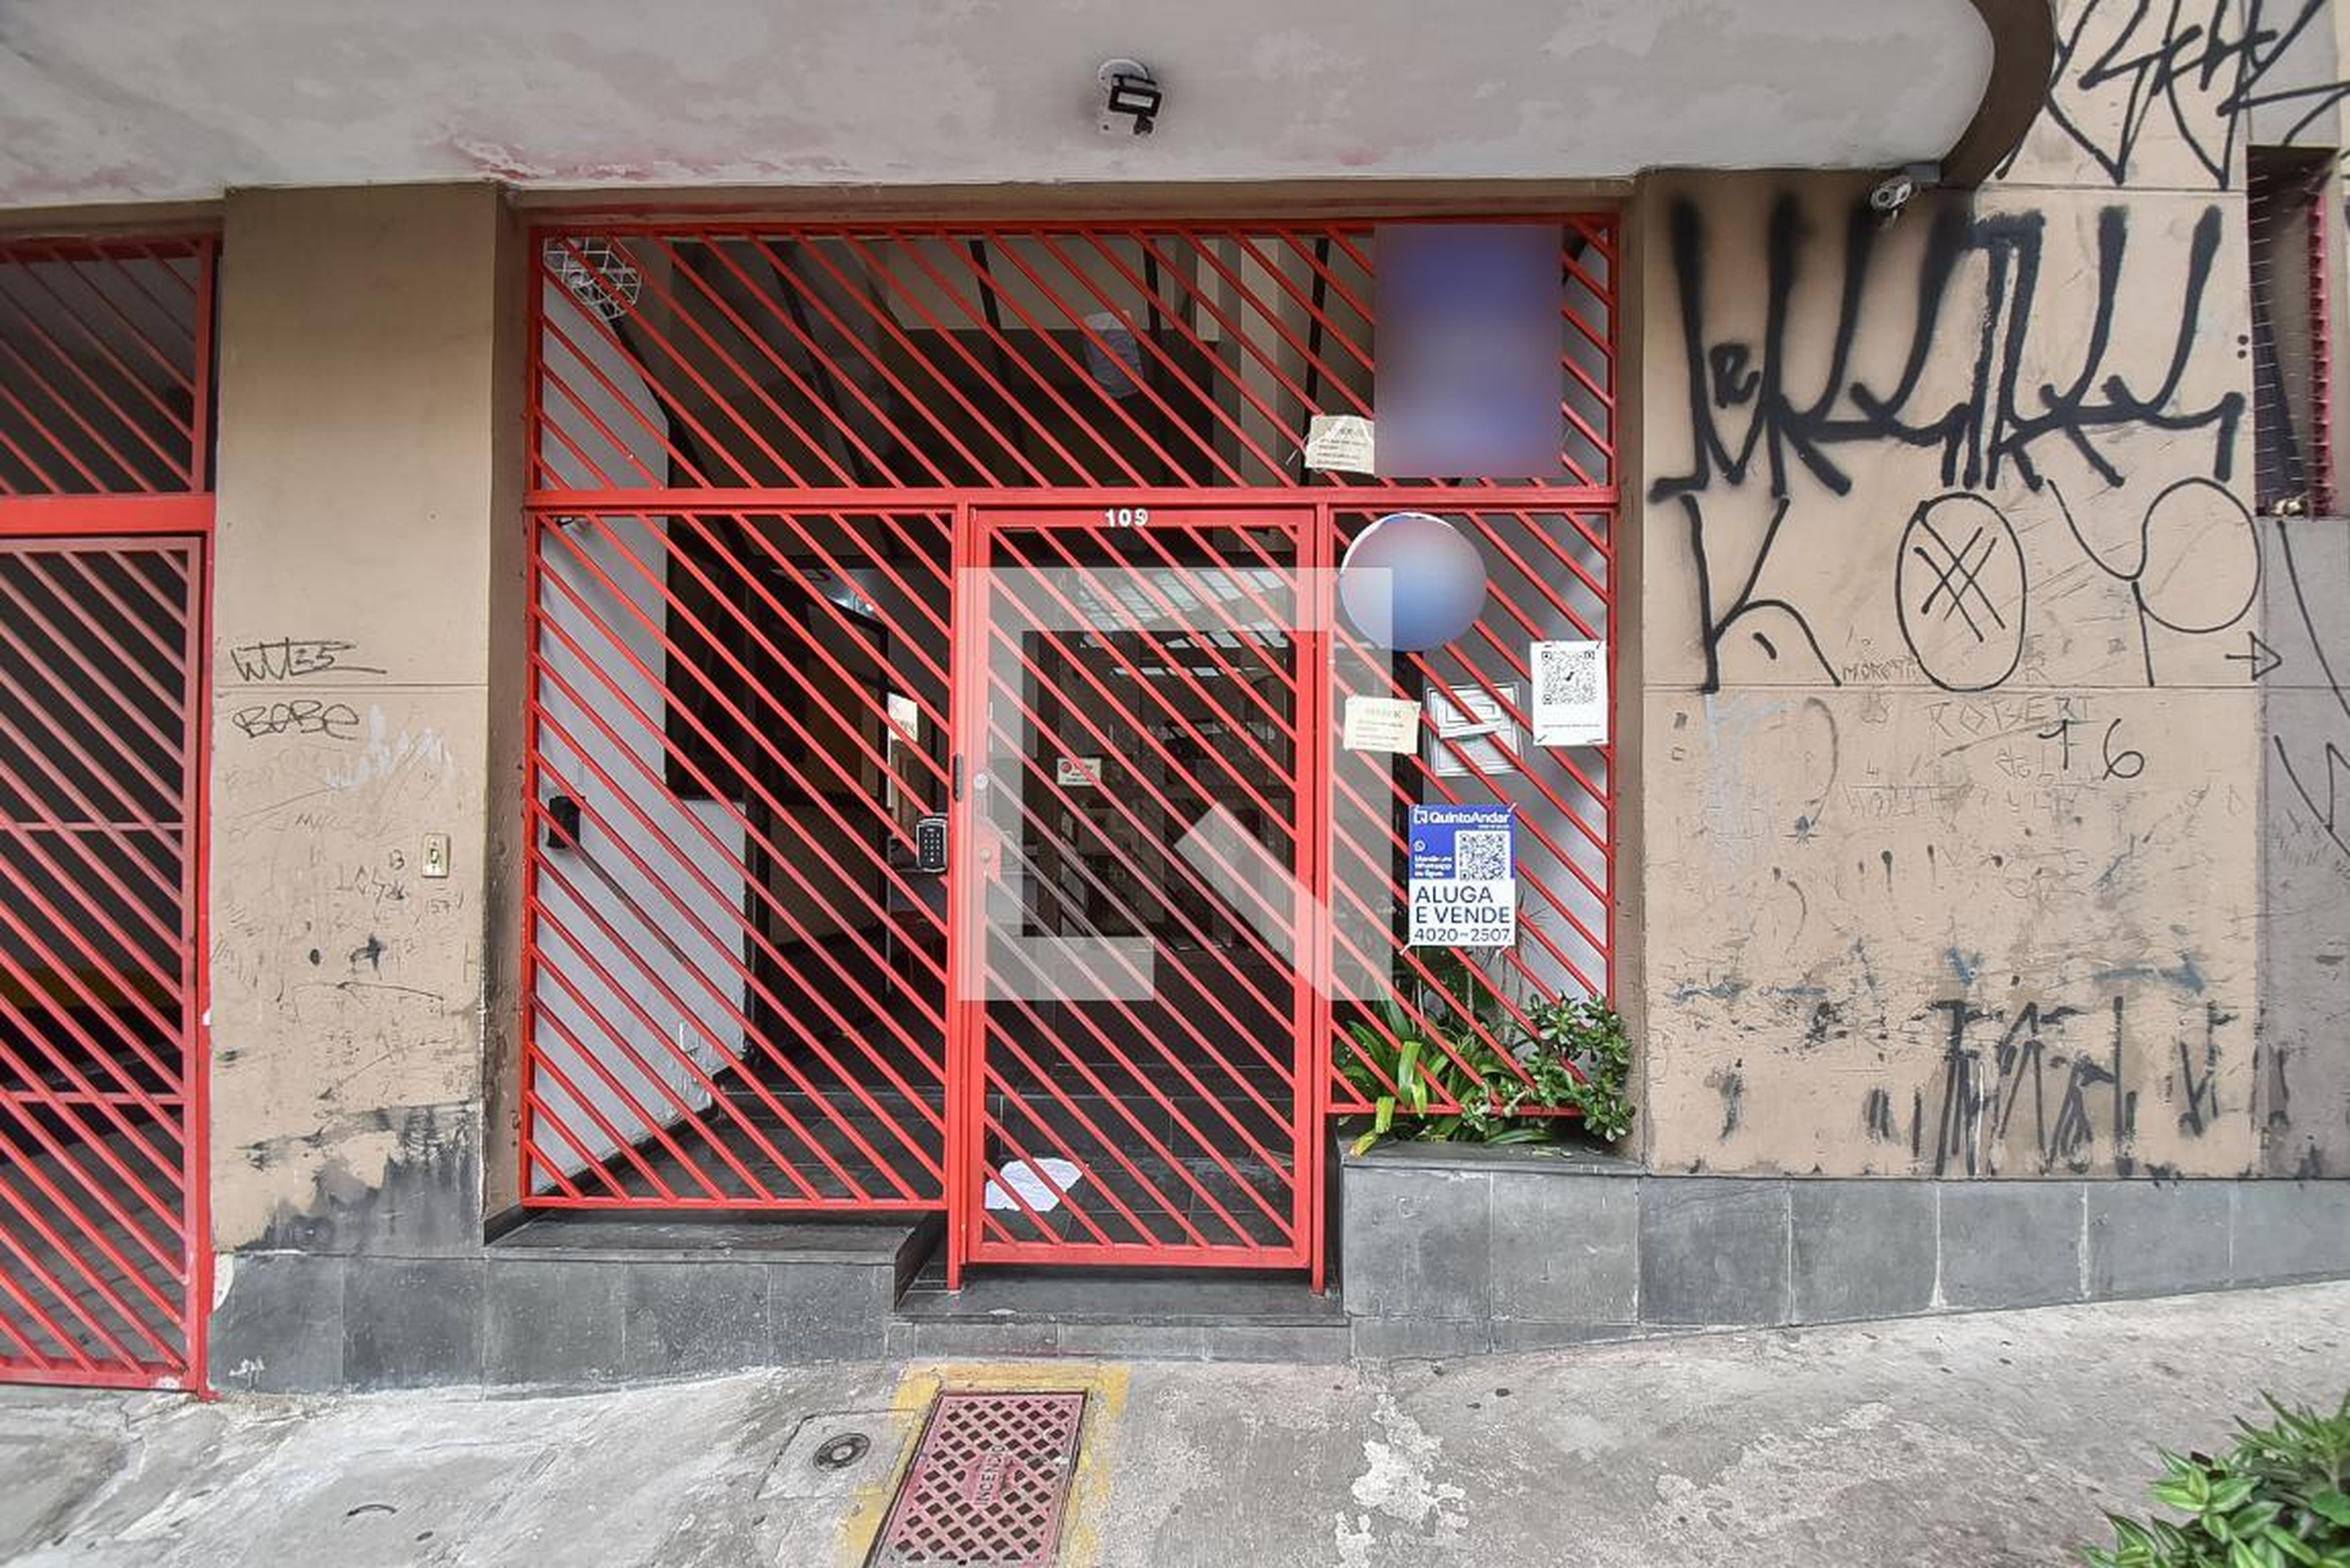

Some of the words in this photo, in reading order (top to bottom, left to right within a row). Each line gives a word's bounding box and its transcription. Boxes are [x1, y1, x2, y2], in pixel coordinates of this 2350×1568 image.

[1105, 509, 1148, 528] 109
[1430, 812, 1510, 824] QuintoAndar
[1415, 886, 1493, 903] ALUGA
[1416, 906, 1427, 924] E
[1434, 906, 1511, 924] VENDE
[1414, 928, 1510, 943] 4020-2507
